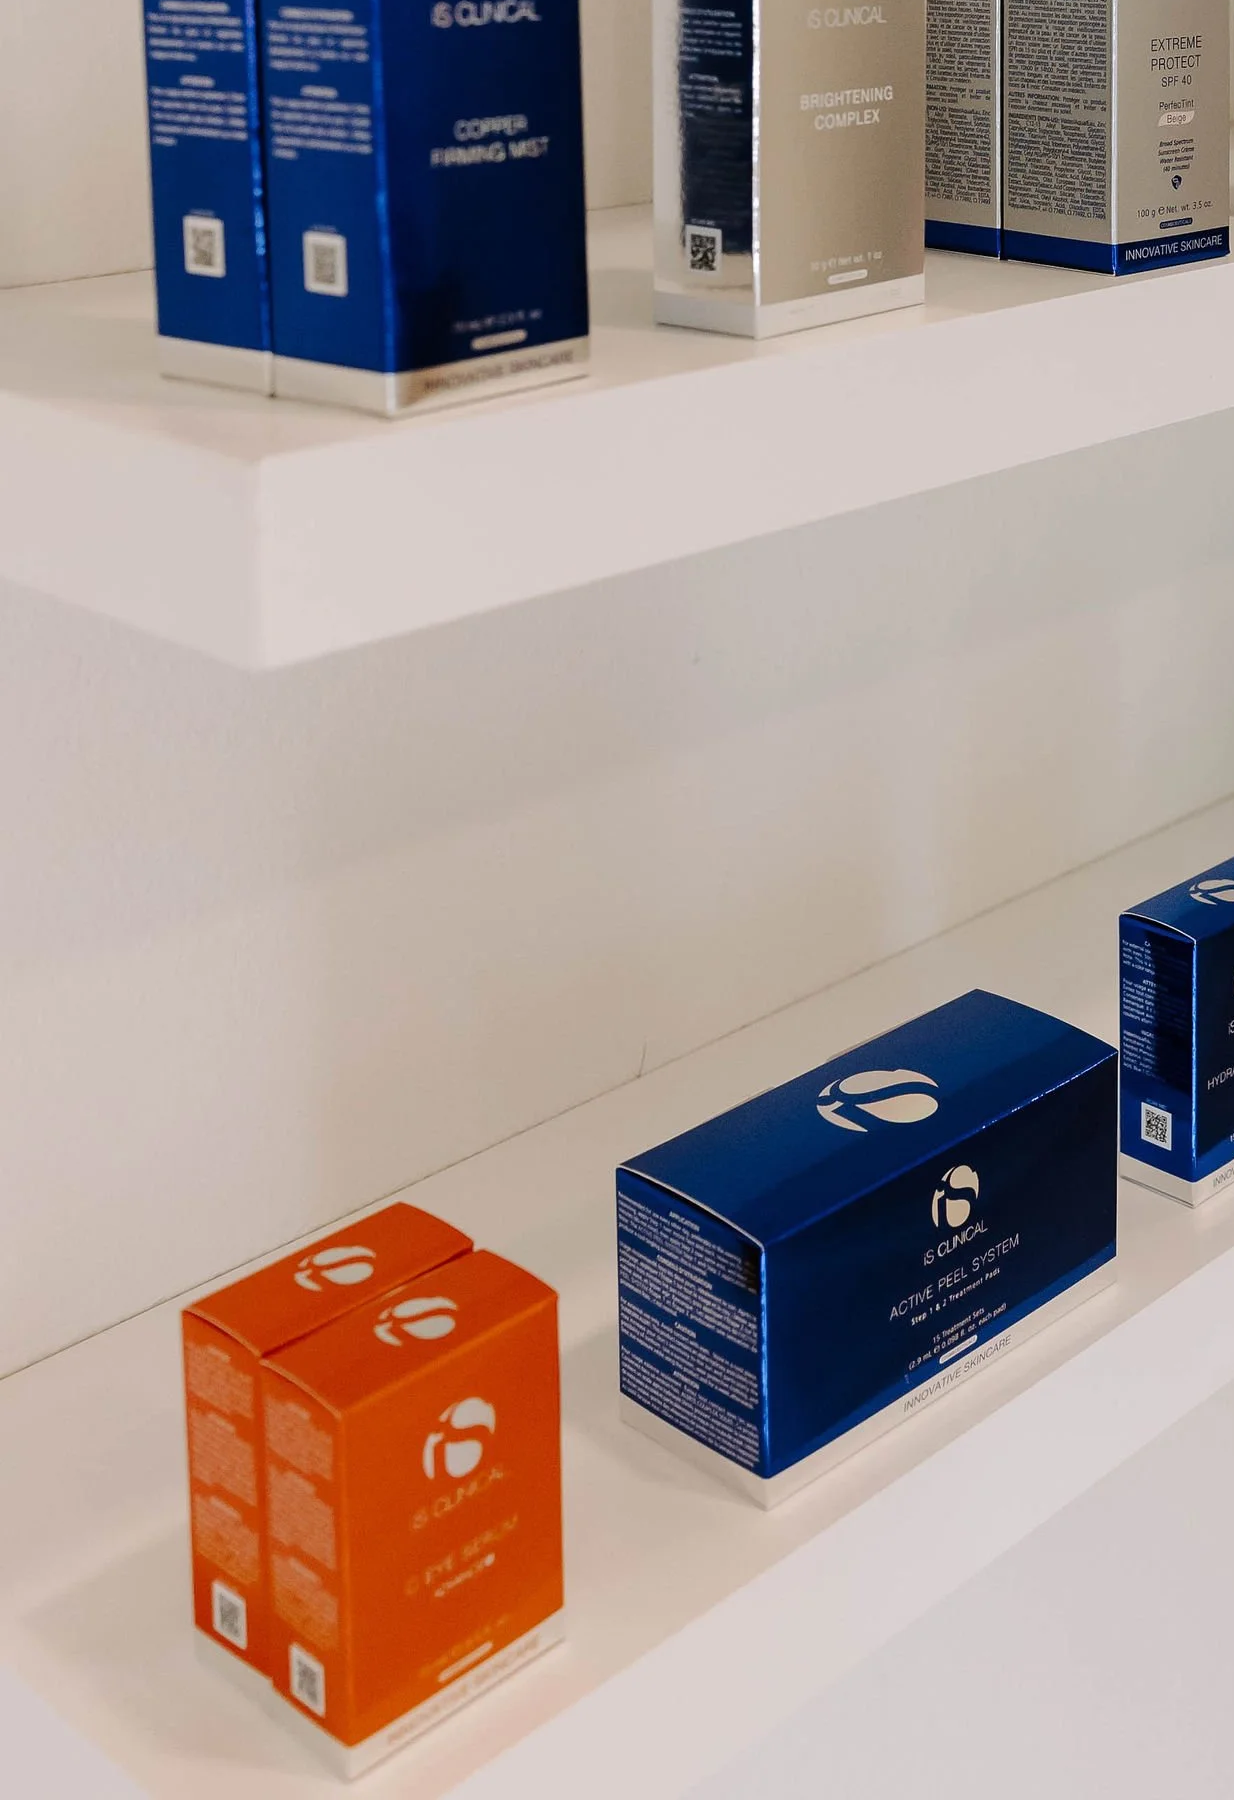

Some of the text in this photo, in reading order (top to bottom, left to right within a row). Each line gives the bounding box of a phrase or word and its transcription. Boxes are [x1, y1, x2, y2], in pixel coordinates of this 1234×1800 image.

[823, 4, 888, 29] CLINICAL
[1150, 35, 1203, 52] EXTREME
[1151, 54, 1202, 72] PROTECT
[1161, 74, 1193, 88] SPF 40
[800, 85, 894, 112] BRIGHTENING
[453, 114, 529, 142] COPPER
[814, 108, 881, 131] COMPLEX
[1166, 114, 1188, 125] Beige
[1137, 208, 1150, 219] 100
[1192, 200, 1203, 210] 3.5
[1125, 234, 1223, 262] INNOVATIVE SKINCARE
[923, 1219, 989, 1267] iS CLINICAL
[889, 1232, 1020, 1321] ACTIVE PEEL SYSTEM
[911, 1311, 928, 1327] Step
[948, 1277, 984, 1303] Treatment
[984, 1266, 1001, 1282] Pads
[908, 1356, 923, 1371] (2.9
[992, 1302, 1008, 1318] pad)
[932, 1307, 986, 1345] 15 Treatment Sets
[903, 1334, 1013, 1413] INNOVATIVE SKINCARE
